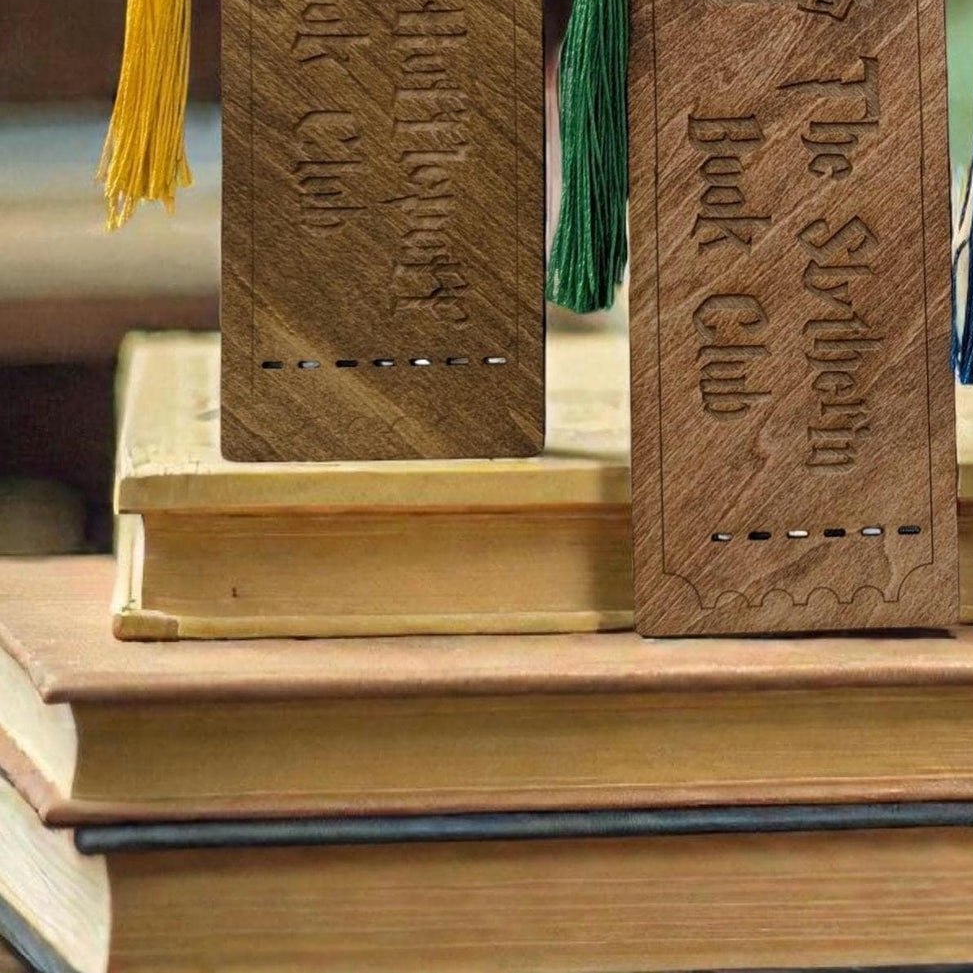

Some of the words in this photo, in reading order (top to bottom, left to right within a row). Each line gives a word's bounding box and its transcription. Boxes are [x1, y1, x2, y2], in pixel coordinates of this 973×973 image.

[294, 109, 368, 234] Club
[378, 0, 470, 329] Hufflepuff
[687, 113, 773, 256] Book
[778, 55, 880, 179] The
[692, 293, 773, 424] Club
[799, 214, 884, 475] Slytherin
